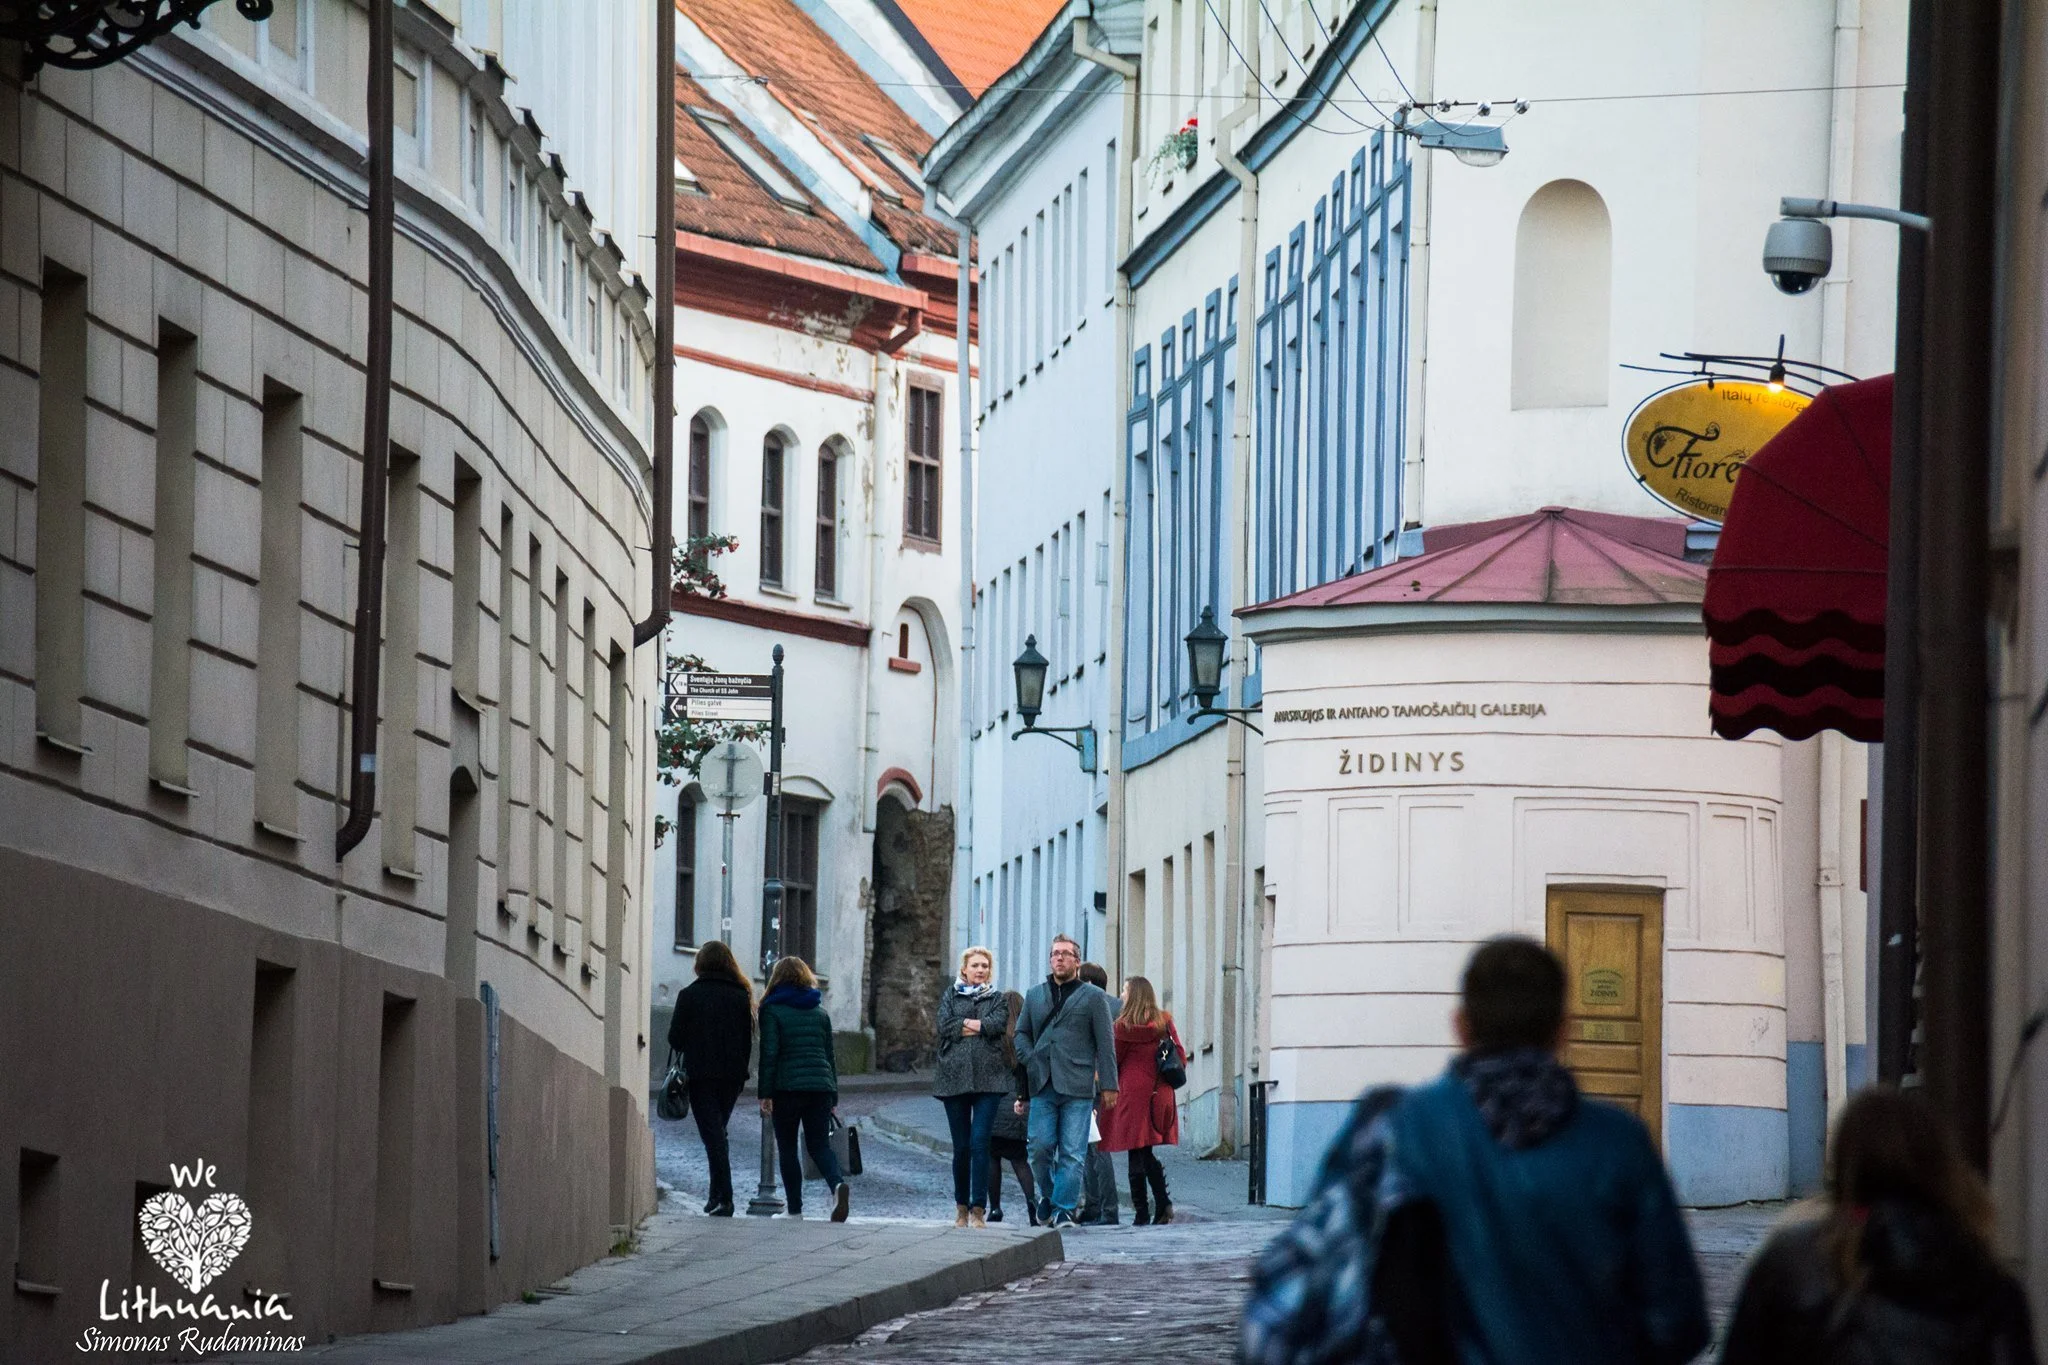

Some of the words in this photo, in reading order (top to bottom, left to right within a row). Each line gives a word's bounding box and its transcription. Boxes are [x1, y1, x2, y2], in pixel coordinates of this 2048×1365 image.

[1722, 389, 1752, 404] Italų
[1755, 391, 1806, 413] restora
[1327, 708, 1337, 720] IR
[1339, 706, 1390, 719] ANTANO
[1392, 701, 1476, 719] TAMOŠAIČIŲ
[1481, 703, 1547, 719] GALERIJA
[1339, 749, 1465, 775] ŽIDINYS
